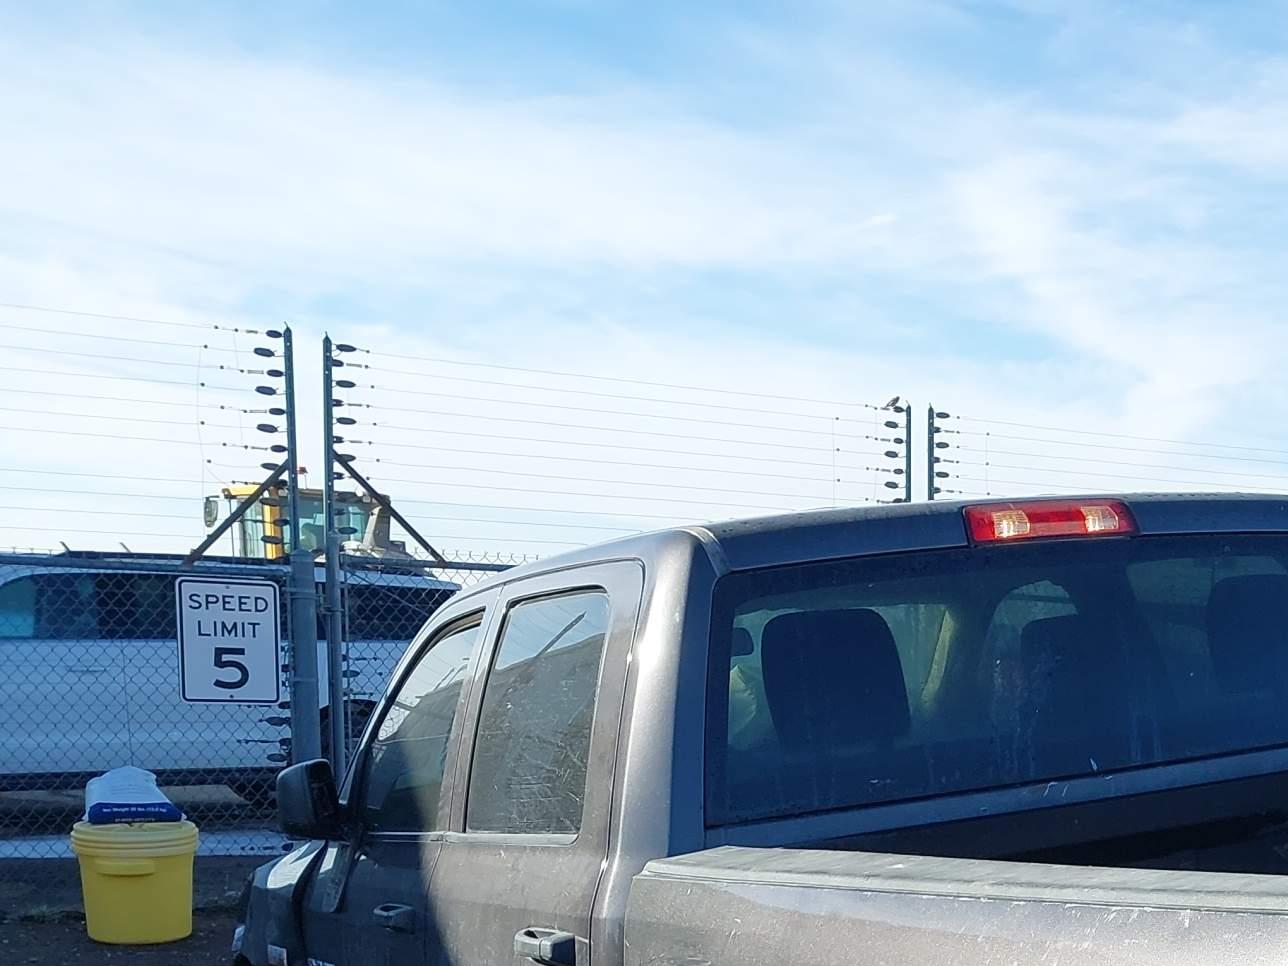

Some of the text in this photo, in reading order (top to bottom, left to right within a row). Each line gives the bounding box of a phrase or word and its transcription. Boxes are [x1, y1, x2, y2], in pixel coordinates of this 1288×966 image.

[188, 593, 269, 613] SPEED
[197, 620, 261, 639] LIMIT
[213, 647, 250, 690] 5
